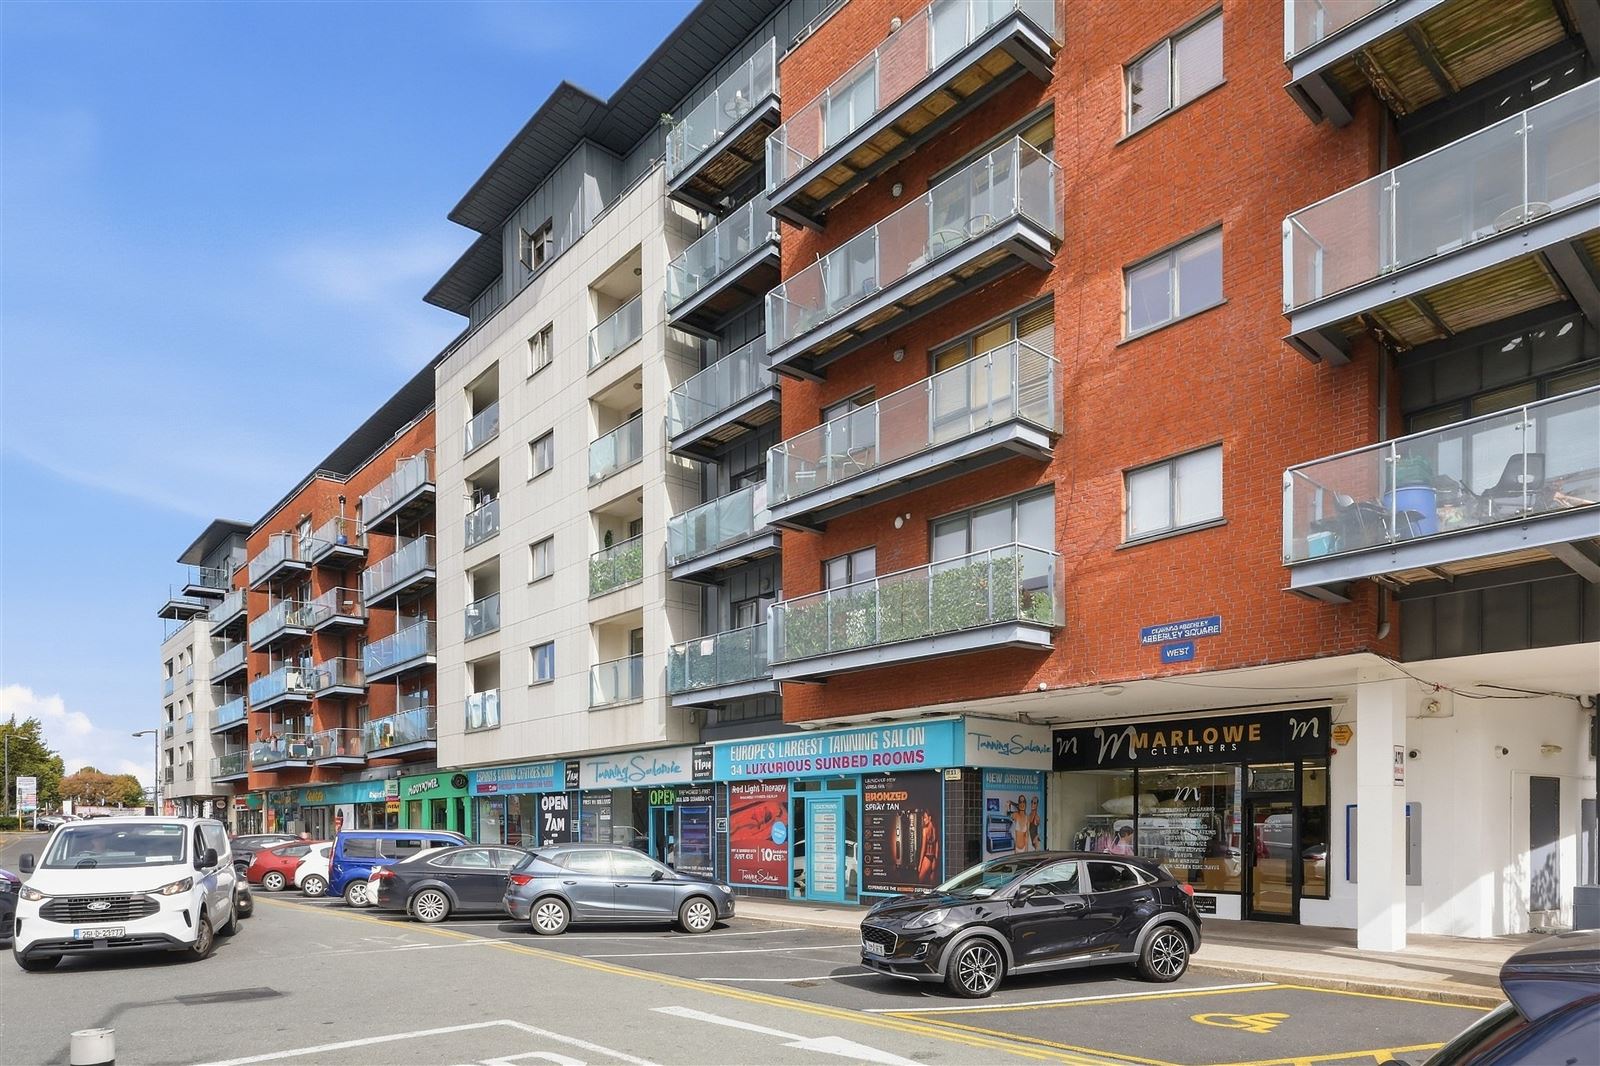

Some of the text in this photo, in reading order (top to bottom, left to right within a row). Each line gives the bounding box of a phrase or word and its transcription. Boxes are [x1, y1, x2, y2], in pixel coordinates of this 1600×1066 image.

[1142, 625, 1220, 644] ABBERLEY SQUARE
[1166, 646, 1190, 657] WEST
[730, 726, 925, 761] EUROPE'S LARGEST TANNING SALON
[968, 732, 1010, 756] Tanning
[1132, 724, 1261, 749] MARLOWE
[1151, 743, 1238, 756] CLEANERS
[730, 749, 925, 775] 34 LUXURIOUS SUNBED ROOMS
[986, 772, 1003, 784] NEW
[744, 784, 760, 794] Light
[761, 784, 787, 793] Therapy
[865, 791, 908, 802] BRONZED
[541, 796, 568, 811] OPEN
[650, 789, 675, 805] OPEN
[865, 803, 900, 811] SPRAY TAN
[544, 813, 565, 831] 7AM
[760, 848, 773, 862] 10
